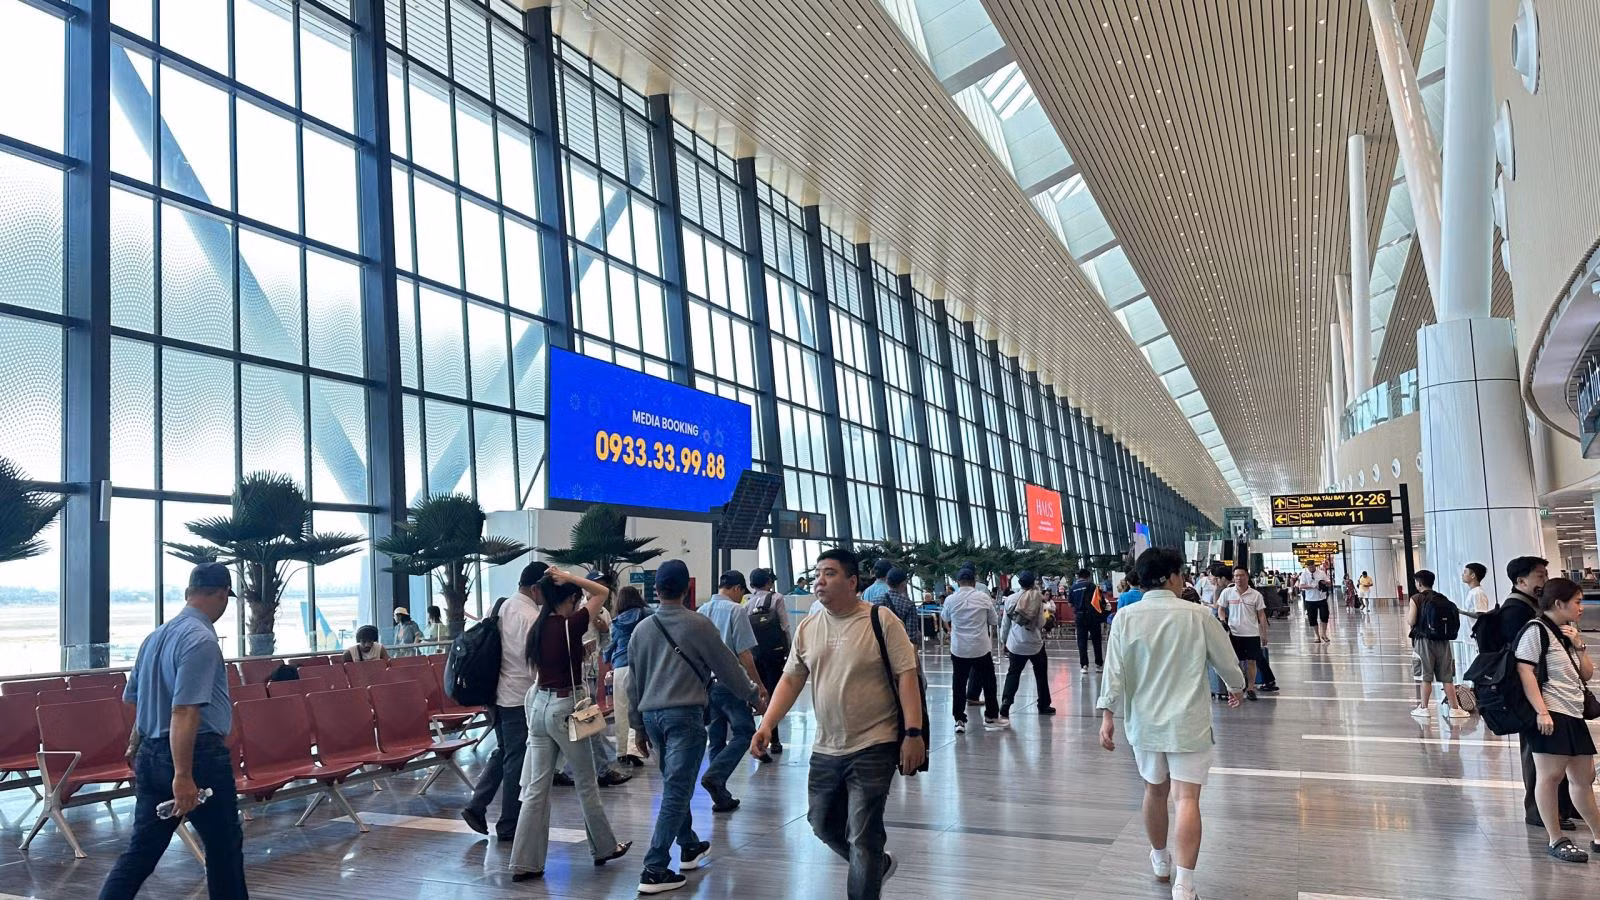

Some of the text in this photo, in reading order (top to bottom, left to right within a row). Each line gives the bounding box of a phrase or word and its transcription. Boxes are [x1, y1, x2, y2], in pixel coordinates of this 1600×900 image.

[632, 410, 699, 436] MEDIA BOOKING
[595, 430, 726, 480] 0933.33.99.88
[1347, 493, 1386, 506] 12-26
[1349, 510, 1364, 523] 11
[799, 517, 809, 534] 11
